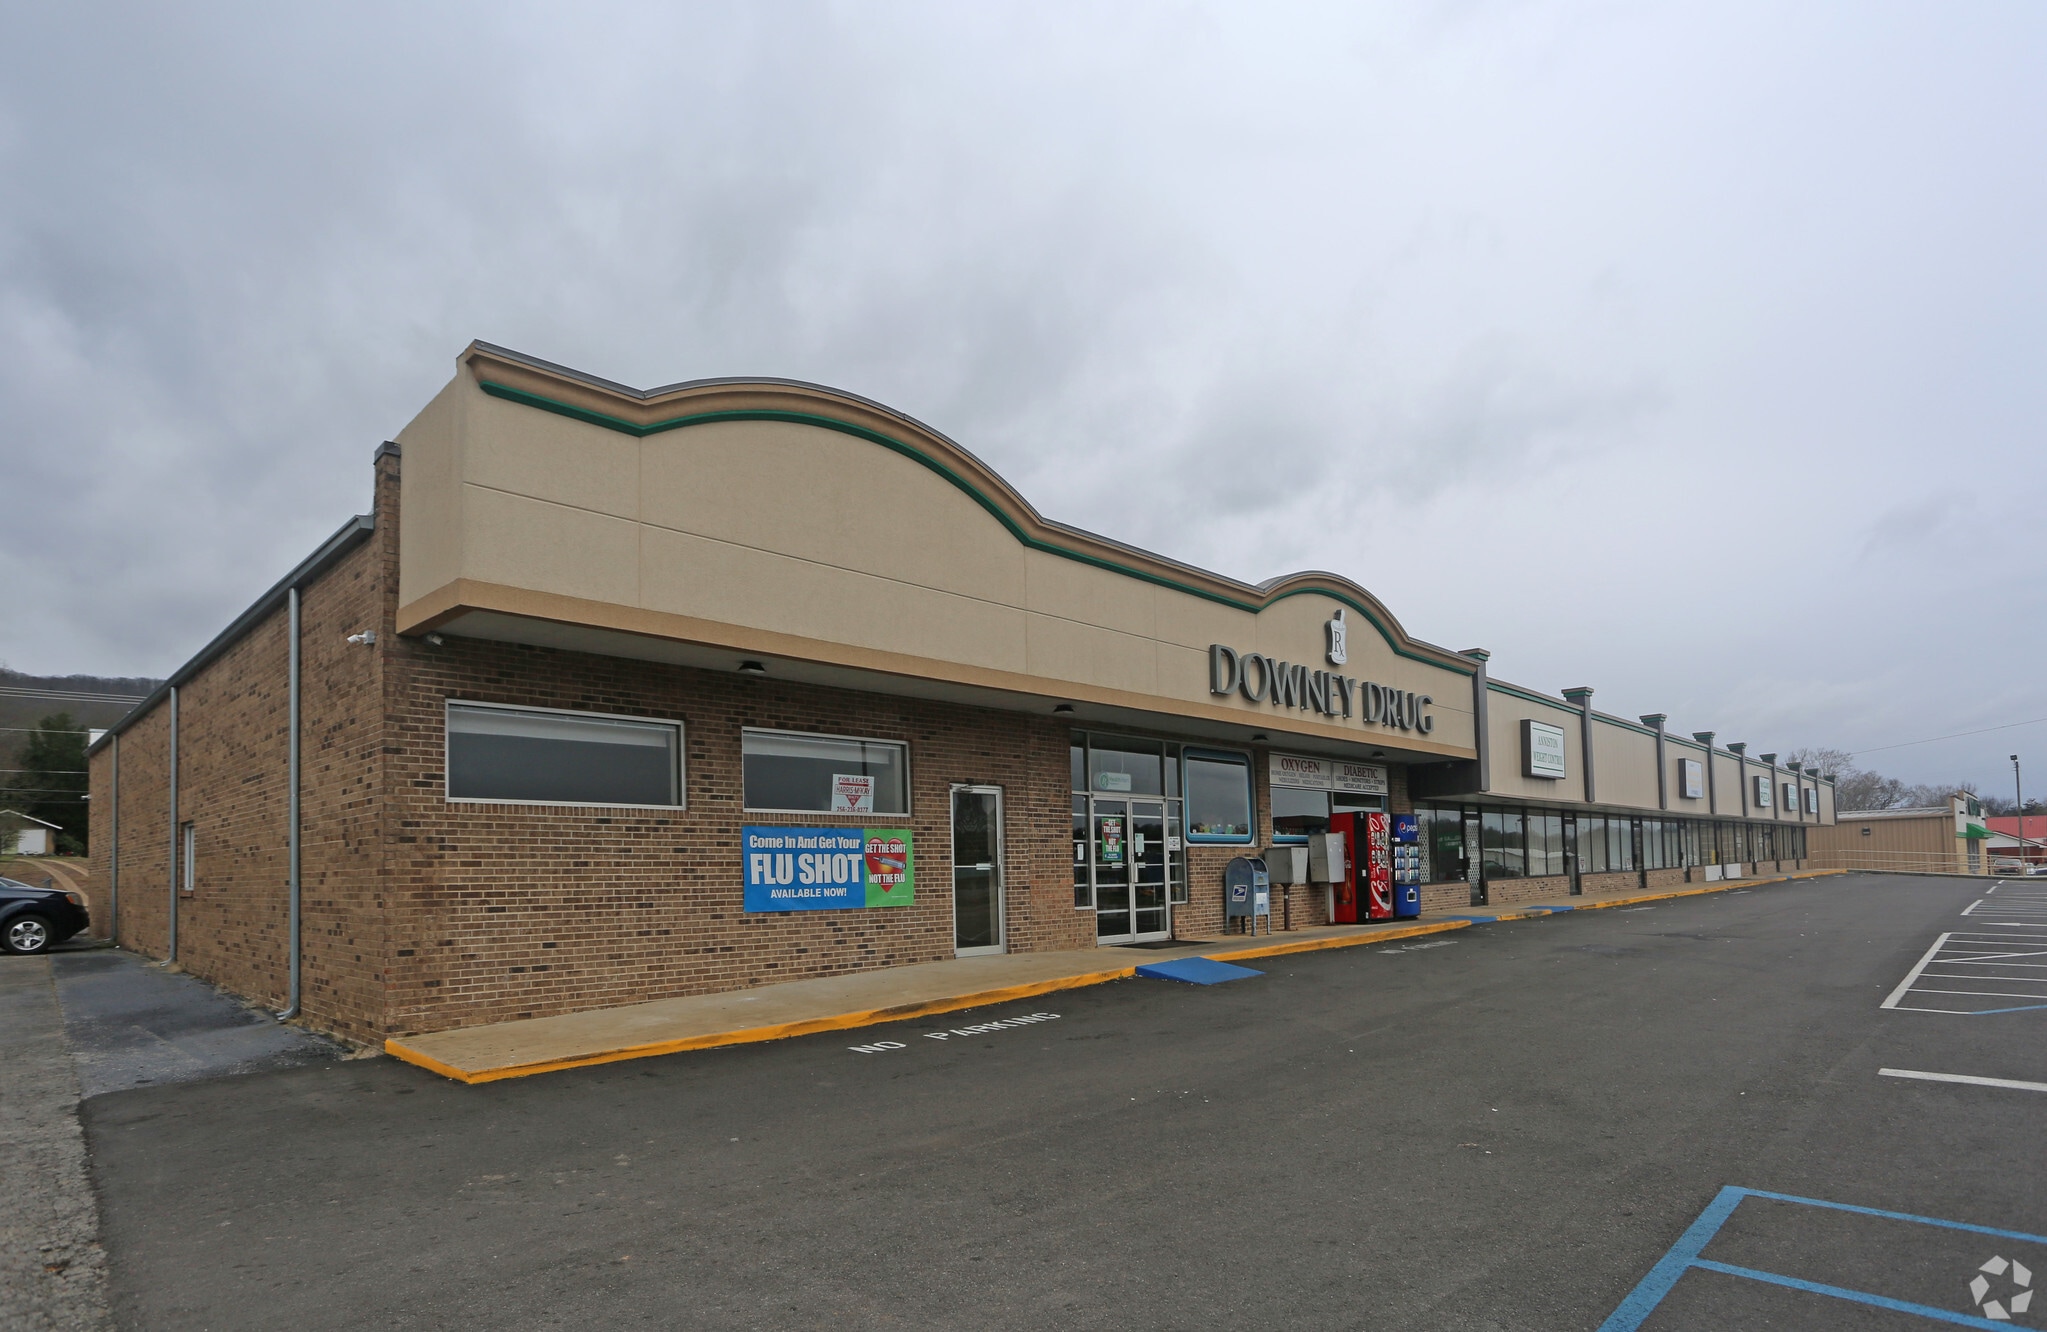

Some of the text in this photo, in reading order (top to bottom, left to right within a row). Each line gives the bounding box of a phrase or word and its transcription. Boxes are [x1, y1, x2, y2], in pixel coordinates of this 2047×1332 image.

[1209, 643, 1434, 734] DOWNEY DRUG
[1281, 758, 1320, 773] OXYGEN
[1344, 765, 1378, 779] DIABETIC
[750, 835, 861, 849] Come In And Get Your
[865, 844, 906, 853] GET THE SHOT
[750, 853, 863, 885] FLU SHOT
[868, 873, 906, 884] NOT THE FLU
[770, 887, 847, 899] AVAILABLE NOW!
[848, 1012, 1061, 1054] NO PARKING
